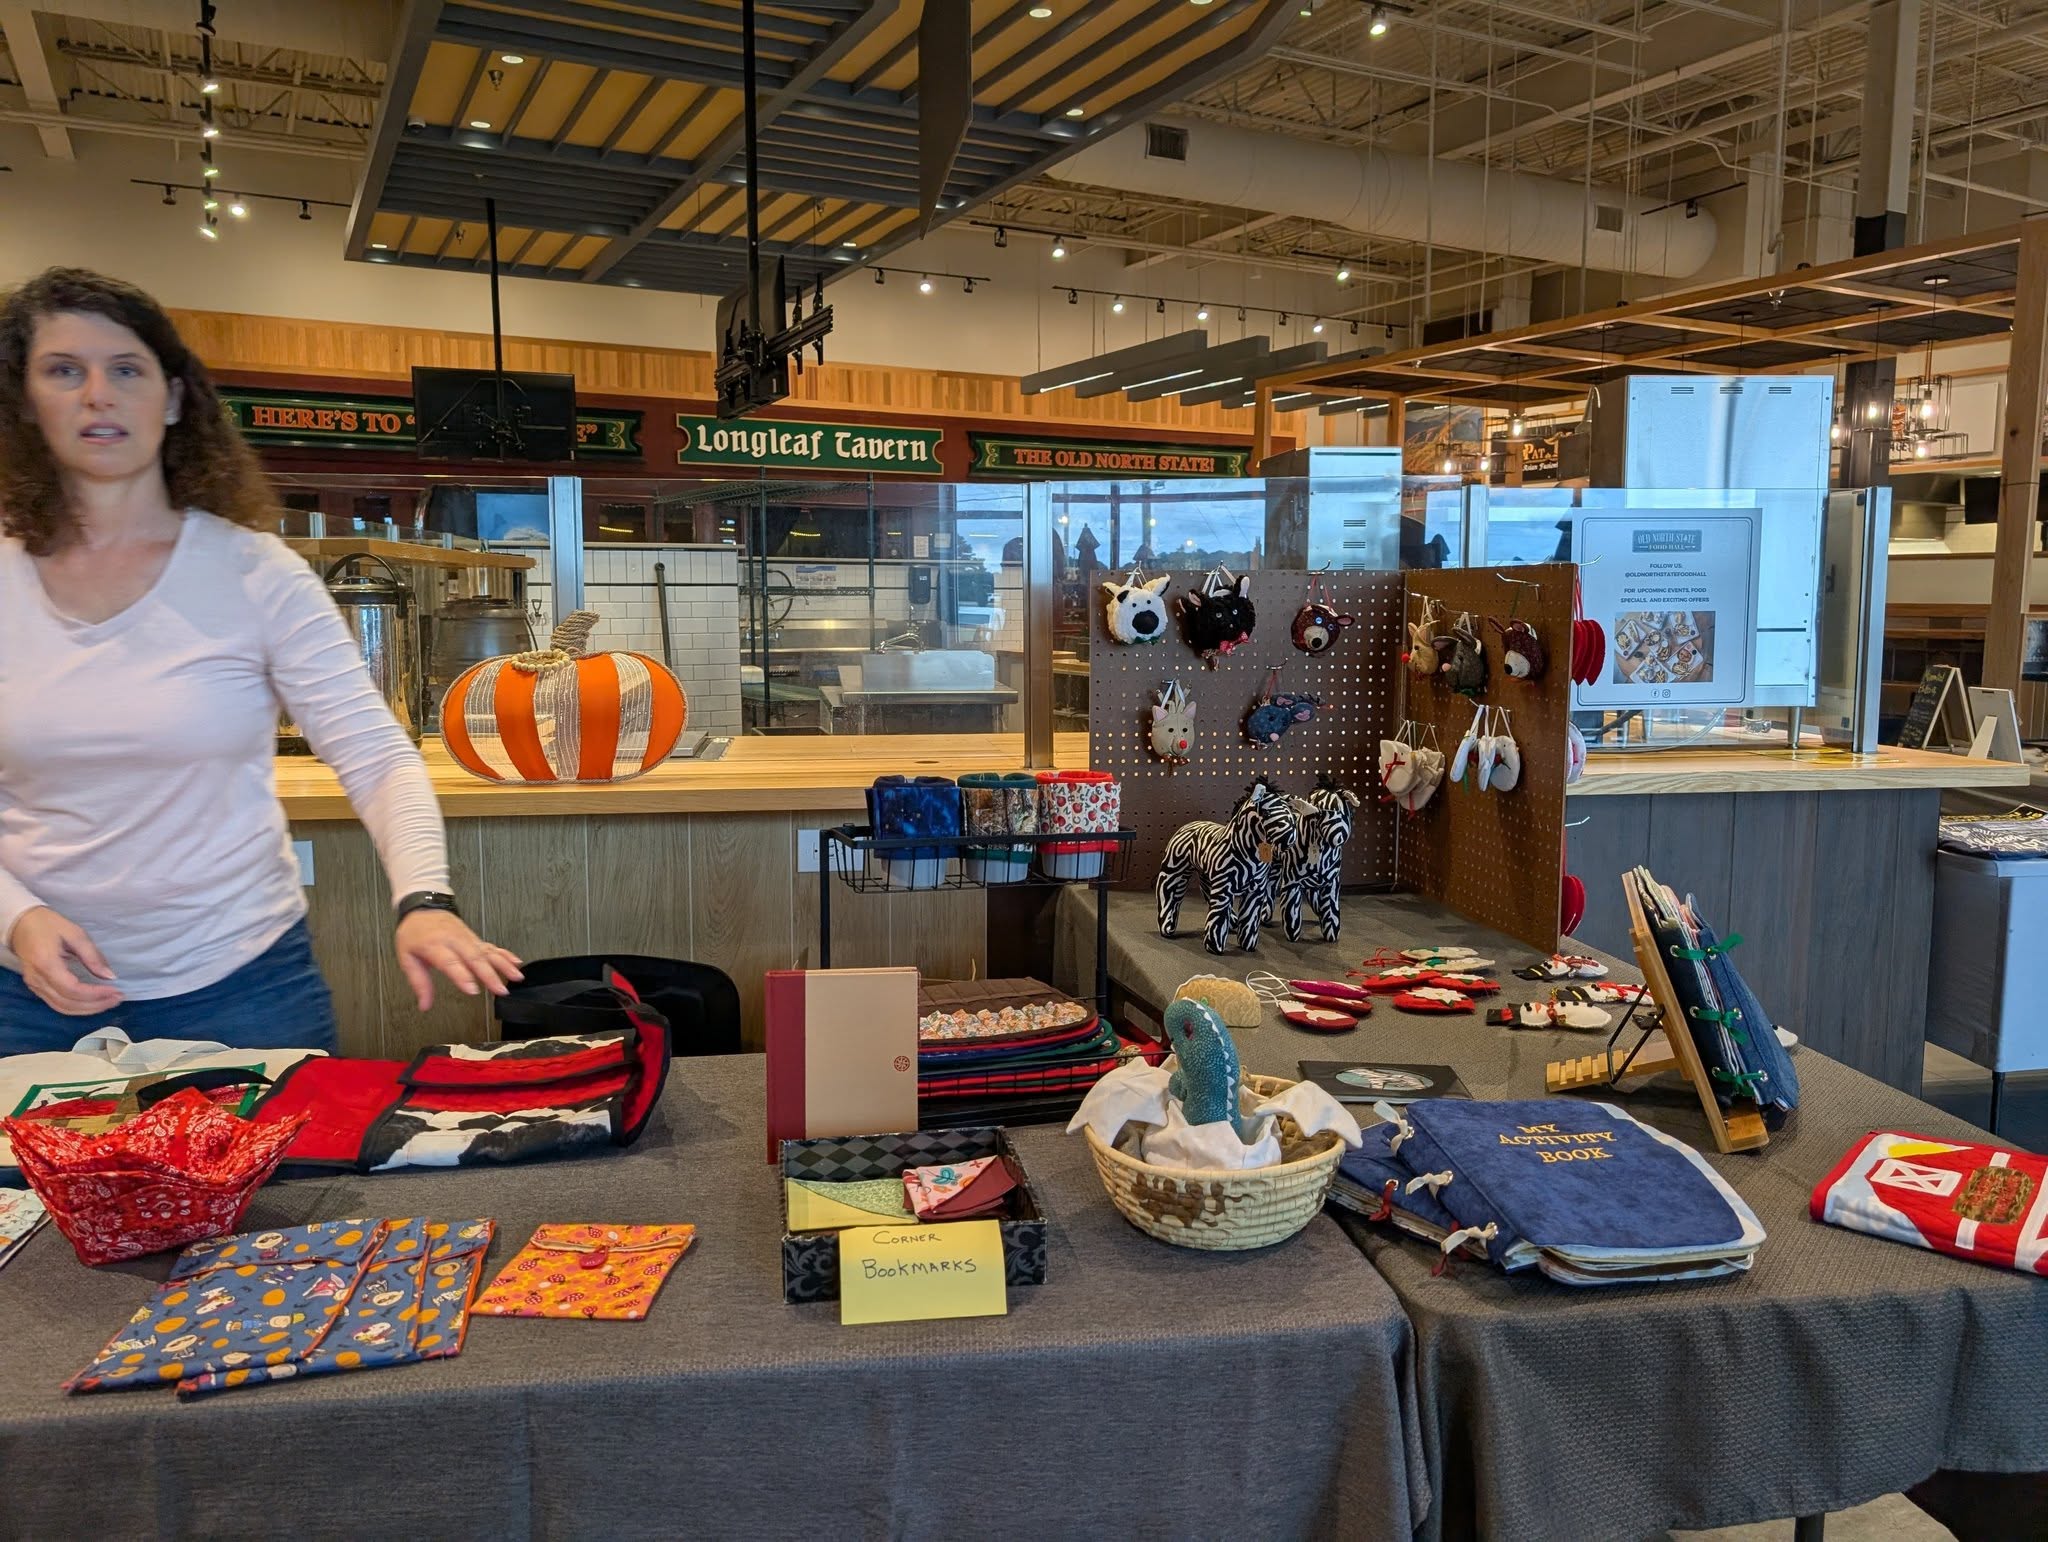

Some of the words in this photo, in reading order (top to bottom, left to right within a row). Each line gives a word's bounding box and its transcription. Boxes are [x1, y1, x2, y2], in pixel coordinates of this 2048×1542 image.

[252, 405, 359, 432] HERE'S
[362, 413, 401, 434] TO
[697, 424, 824, 461] Longleaf
[834, 431, 928, 462] Tavern
[1014, 449, 1051, 466] THE
[1055, 451, 1093, 468] OLD
[1095, 453, 1156, 471] NORTH
[1158, 455, 1215, 473] STATE!
[1637, 533, 1651, 545] OLD
[1652, 532, 1674, 543] NORTH
[1675, 532, 1697, 545] STATE
[1516, 1123, 1560, 1135] MY
[1499, 1131, 1617, 1146] ACTIVITY
[1536, 1147, 1613, 1164] BOOK
